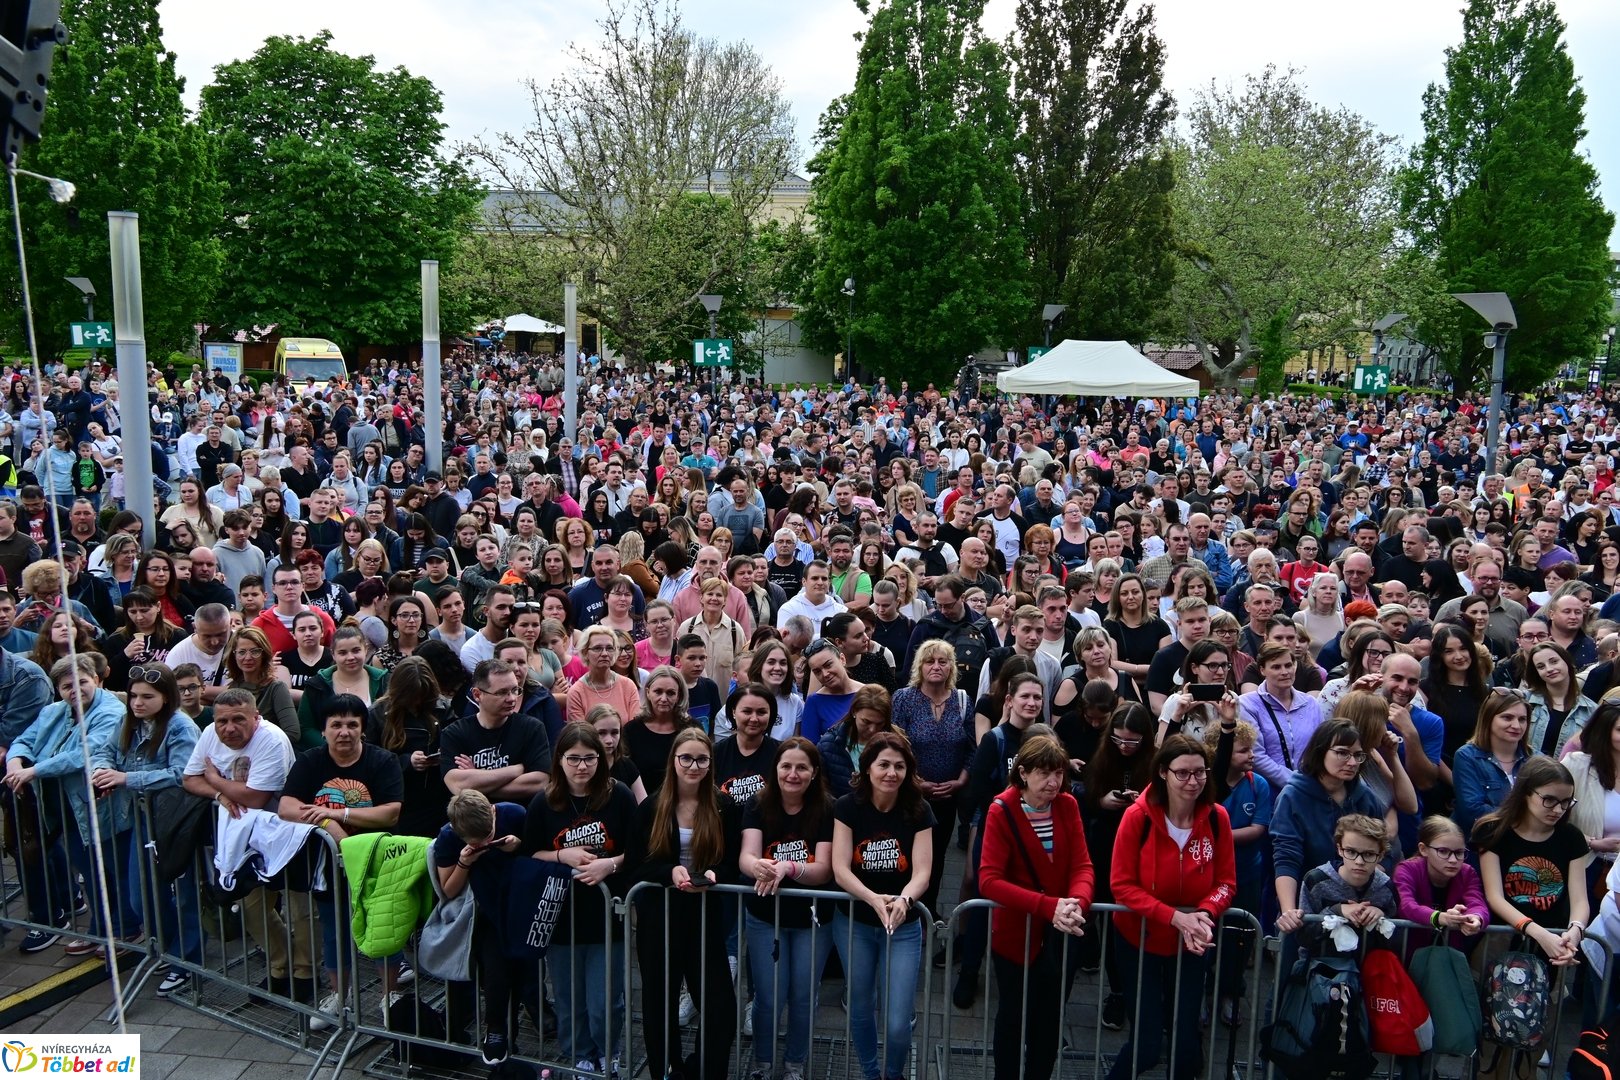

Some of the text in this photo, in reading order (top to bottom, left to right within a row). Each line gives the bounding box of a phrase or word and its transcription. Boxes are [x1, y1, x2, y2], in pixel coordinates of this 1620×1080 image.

[732, 774, 761, 787] BAGOSSY
[729, 781, 766, 795] BROTHERS
[566, 821, 601, 842] BAGOSSY
[777, 839, 805, 853] BAGOSSY
[866, 838, 897, 851] BAGOSSY
[384, 843, 408, 861] MAY
[773, 849, 808, 862] BROTHERS
[862, 849, 900, 862] BROTHERS
[1515, 881, 1539, 896] NAP
